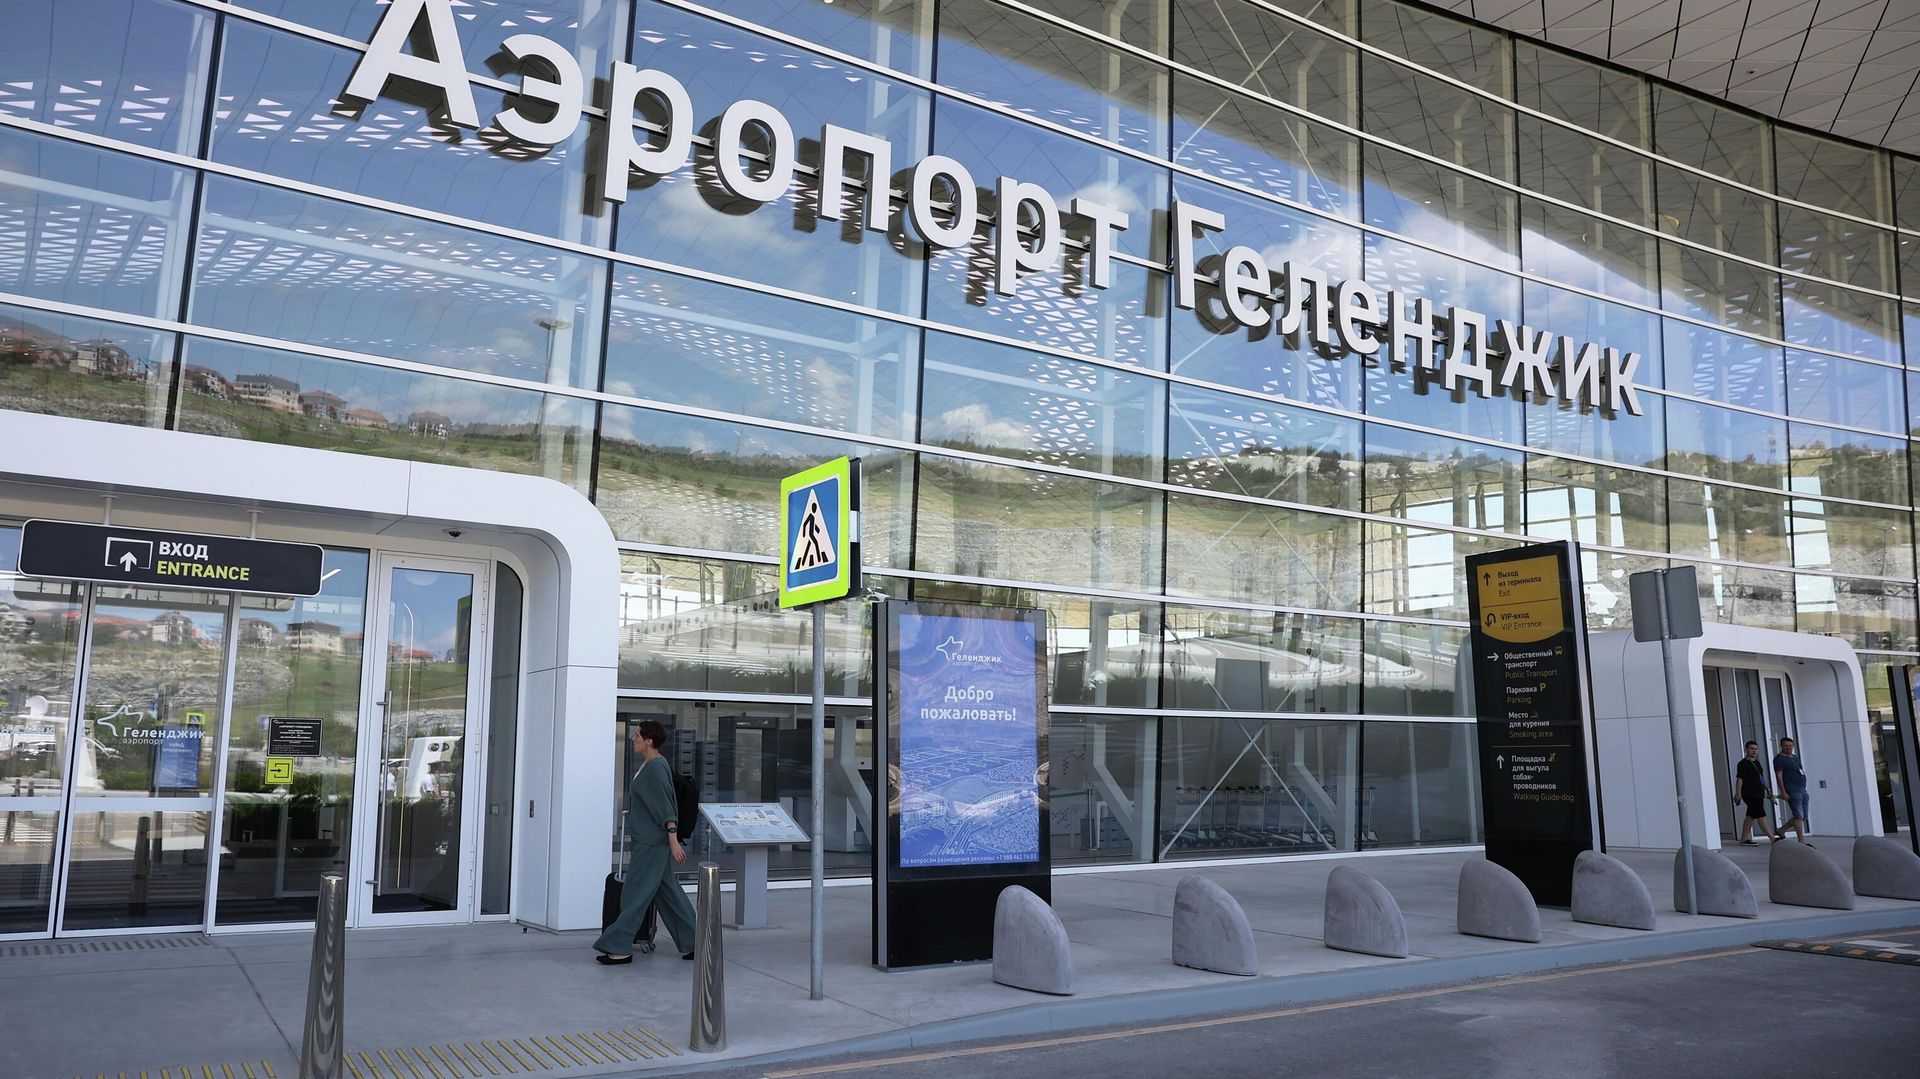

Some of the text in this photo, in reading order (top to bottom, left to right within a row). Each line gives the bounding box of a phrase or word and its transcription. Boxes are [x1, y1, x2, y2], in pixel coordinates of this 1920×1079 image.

[344, 0, 1643, 417] Аэропорт Геленджик
[159, 541, 208, 561] ВХОД
[157, 560, 250, 581] ENTRANCE
[1497, 570, 1519, 578] Выход
[1507, 576, 1541, 586] терминала
[1500, 612, 1530, 621] VIP-вход
[1513, 621, 1542, 630] Entrance
[951, 652, 1002, 663] Геленджик
[1504, 649, 1553, 660] Общественный
[1504, 660, 1537, 670] транспорт
[1505, 669, 1558, 679] Public Transport
[944, 685, 994, 704] Добро
[1506, 686, 1538, 694] Парковка
[1506, 696, 1532, 704] Parking
[920, 706, 1017, 722] пожаловать!
[1508, 711, 1529, 719] Место
[1508, 720, 1550, 729] для курения
[123, 727, 206, 739] Геленджик
[1509, 731, 1537, 739] Smoking
[1511, 755, 1546, 763] Площадка
[1513, 783, 1557, 791] проводников
[1513, 793, 1575, 803] Walking Guide-dog
